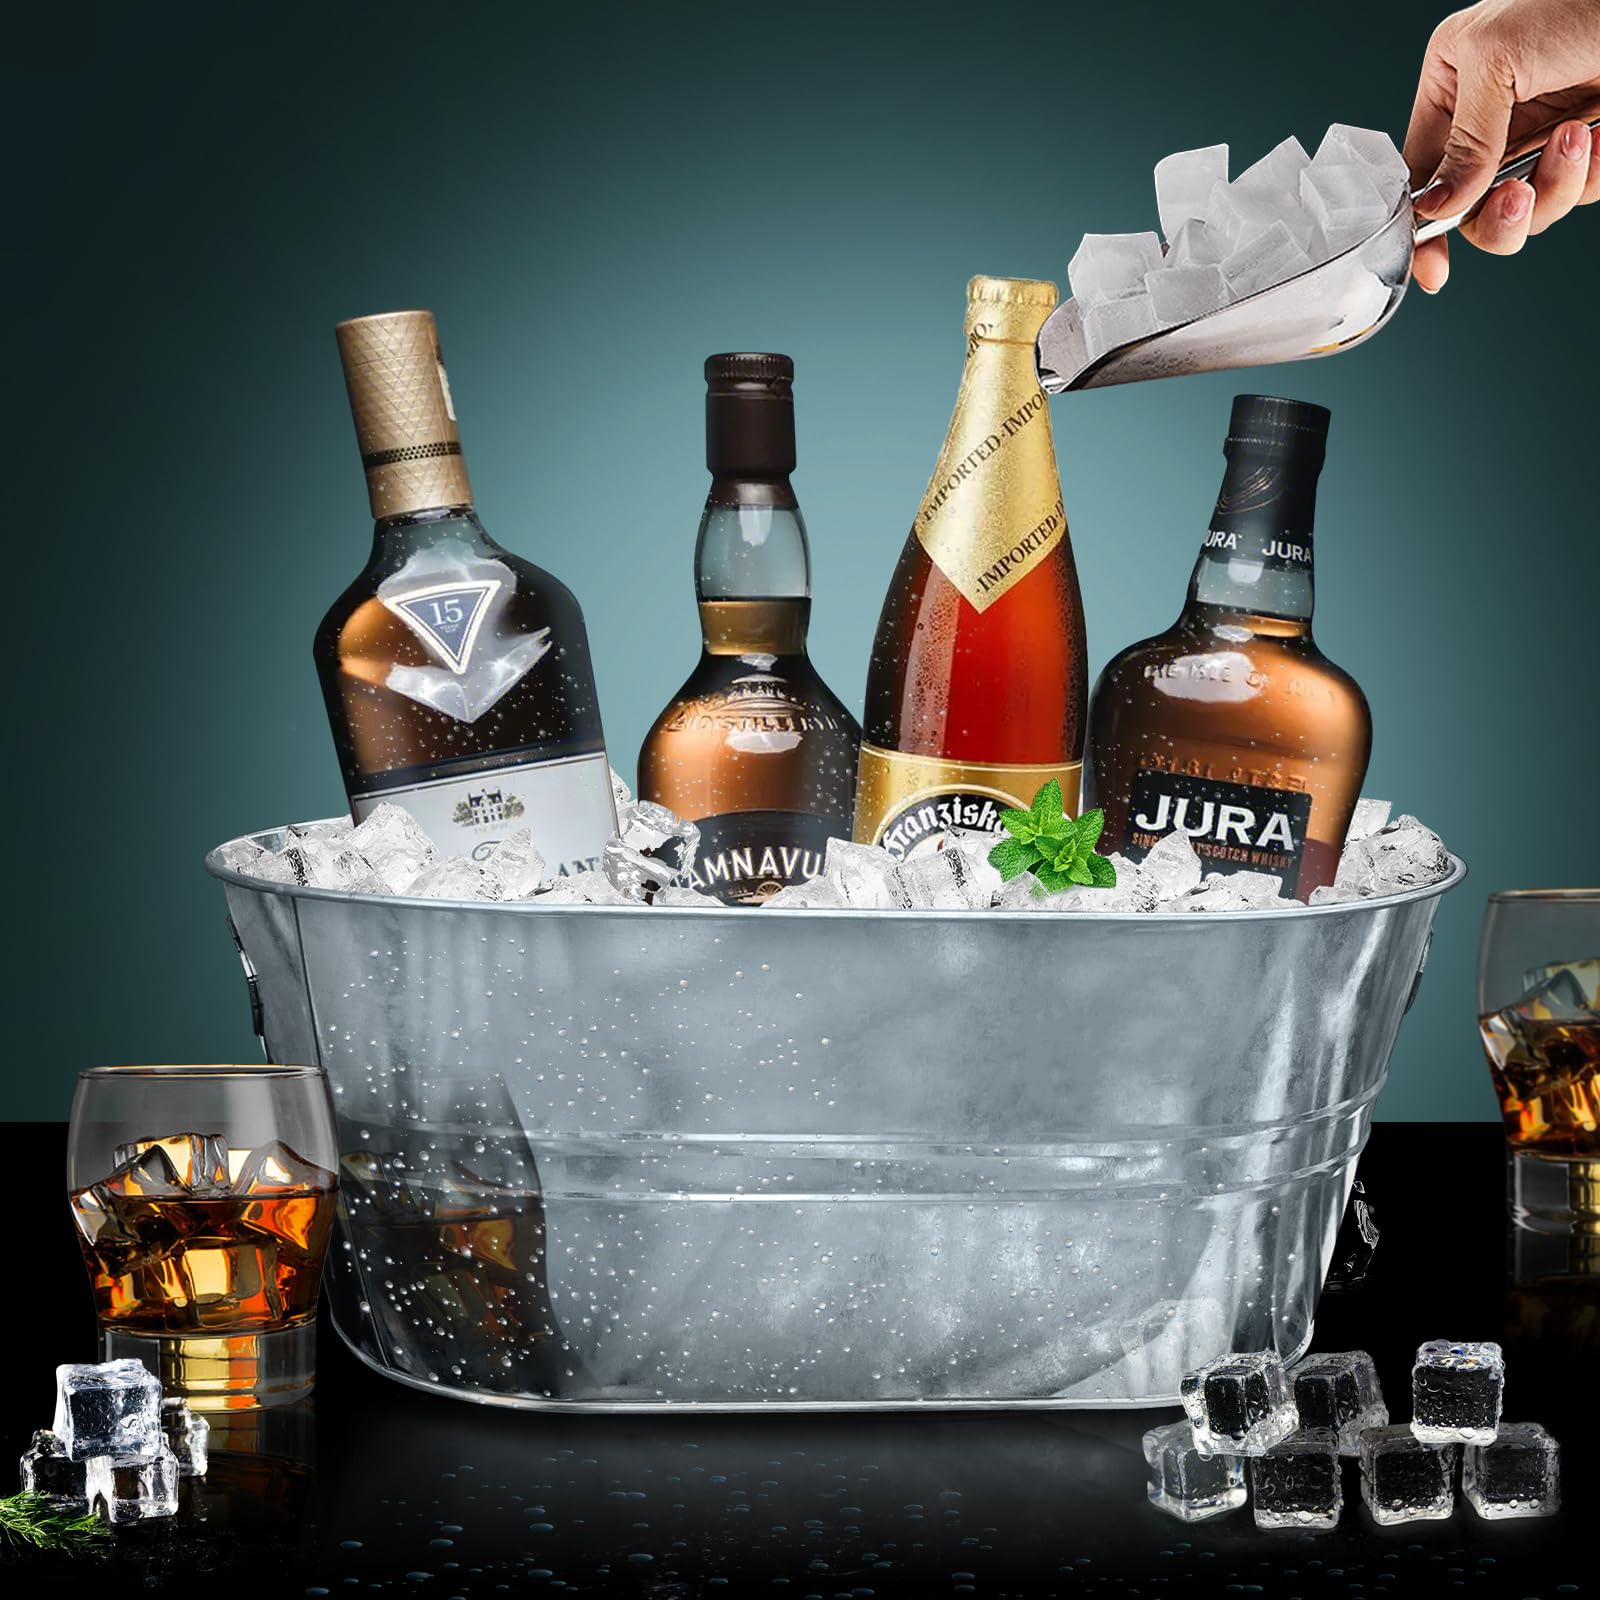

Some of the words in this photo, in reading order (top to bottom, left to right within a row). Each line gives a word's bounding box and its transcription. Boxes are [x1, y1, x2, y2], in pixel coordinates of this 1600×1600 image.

[924, 435, 1001, 521] IMPORTED
[976, 514, 1057, 593] IMPORTED
[1261, 540, 1312, 563] JURA
[429, 599, 463, 626] 15
[1134, 794, 1295, 851] JURA
[688, 847, 822, 890] AMNAVU
